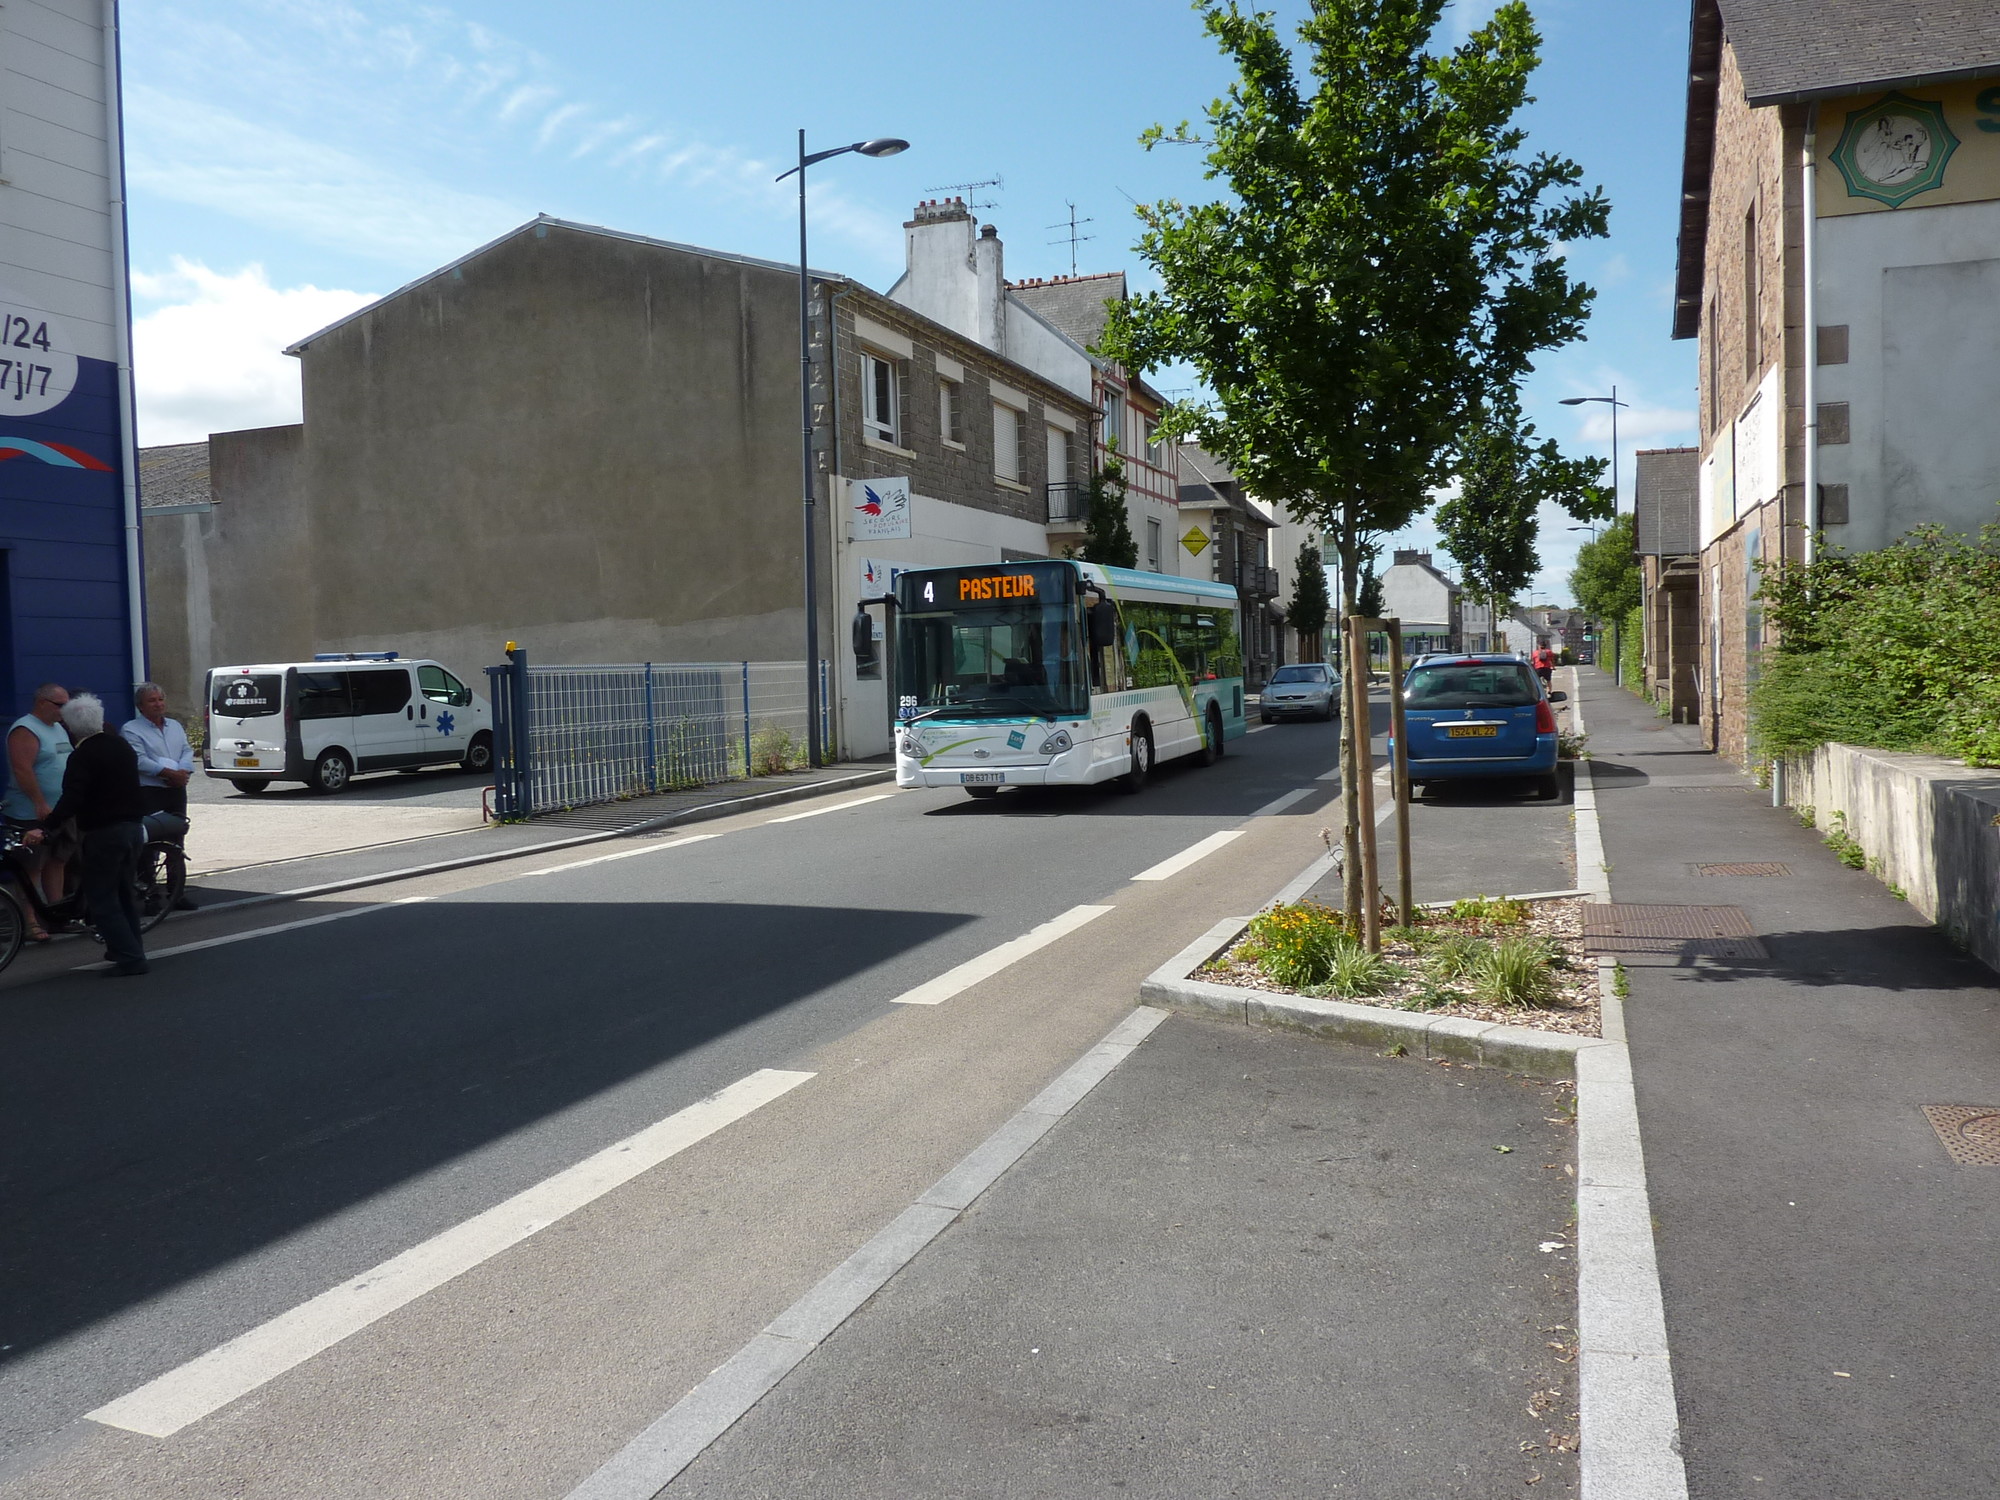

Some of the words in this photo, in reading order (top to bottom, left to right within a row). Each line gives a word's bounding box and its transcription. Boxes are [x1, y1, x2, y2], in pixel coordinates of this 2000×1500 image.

[863, 515, 901, 525] SECOURS
[923, 581, 935, 603] 4
[960, 574, 1035, 601] PASTEUR
[900, 695, 918, 707] 296
[1451, 728, 1471, 737] 1524
[1472, 727, 1482, 736] WL
[1484, 727, 1495, 736] 22
